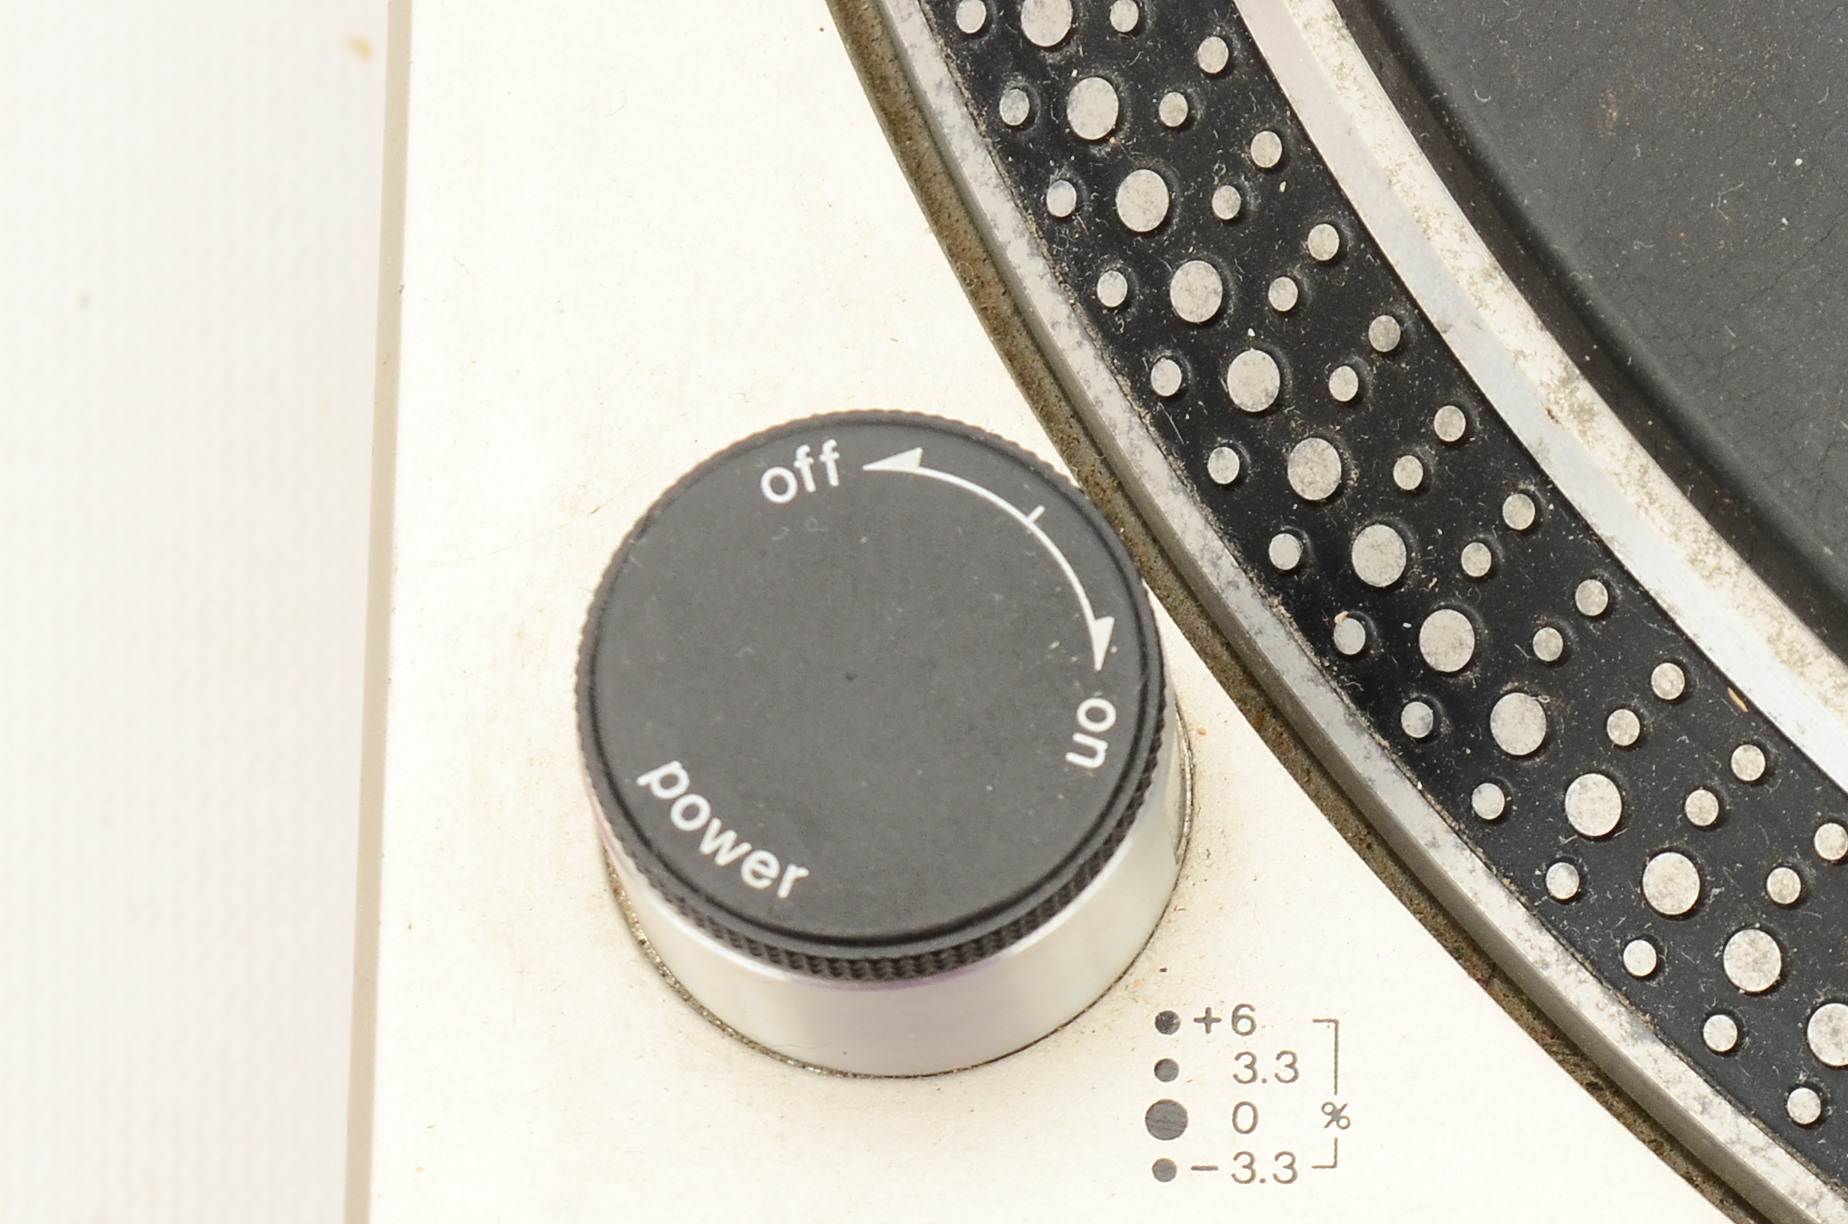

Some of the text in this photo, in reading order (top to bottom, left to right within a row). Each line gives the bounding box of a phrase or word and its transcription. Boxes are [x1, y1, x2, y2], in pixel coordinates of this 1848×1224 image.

[760, 439, 841, 503] off
[1065, 697, 1117, 769] on
[636, 761, 809, 898] power
[1193, 1003, 1257, 1036] +6
[1233, 1050, 1299, 1084] 3.3
[1231, 1101, 1259, 1134] 0
[1321, 1101, 1351, 1130] %
